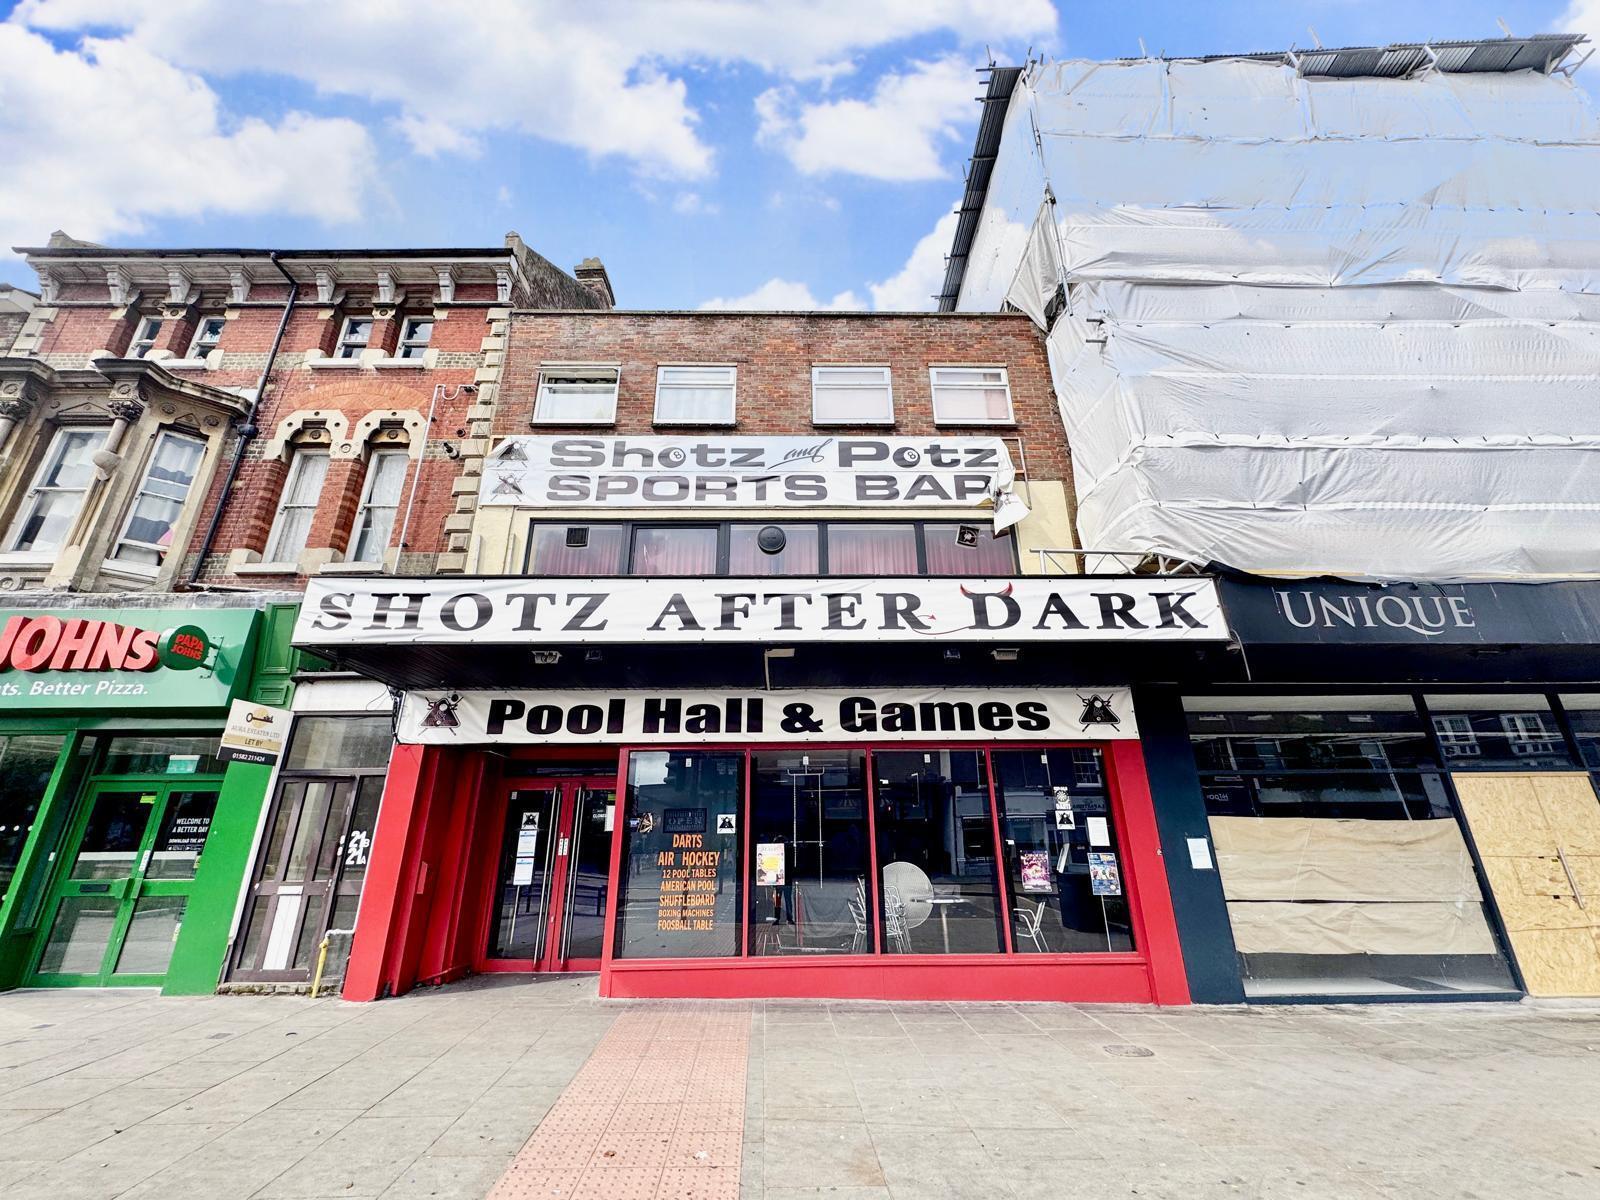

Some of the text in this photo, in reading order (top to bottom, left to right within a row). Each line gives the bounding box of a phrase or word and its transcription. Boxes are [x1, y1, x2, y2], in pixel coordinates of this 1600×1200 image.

[550, 438, 1000, 469] Shotz and Potz
[546, 474, 828, 502] SPORTS
[310, 590, 1209, 632] SHOTZ AFTER DARK
[1274, 591, 1476, 636] UNIQUE
[0, 614, 162, 673] JOHNS
[175, 634, 204, 651] PAPA
[170, 644, 203, 660] JOHNS
[0, 679, 149, 696] ts. Better Pizza.
[486, 696, 1051, 735] Pool Hall & Games
[244, 738, 254, 746] LET
[176, 817, 210, 825] WELCOME TO
[672, 833, 704, 848] DARTS
[657, 851, 721, 866] AIR HOCKEY
[662, 868, 717, 879] 12 POOL TABLES
[660, 880, 716, 891] AMERICAN POOL
[659, 894, 715, 907] SHUFFLEBOARD
[658, 909, 714, 918] BOXING MACHINES
[658, 919, 714, 931] FOOSBALL TABLE
